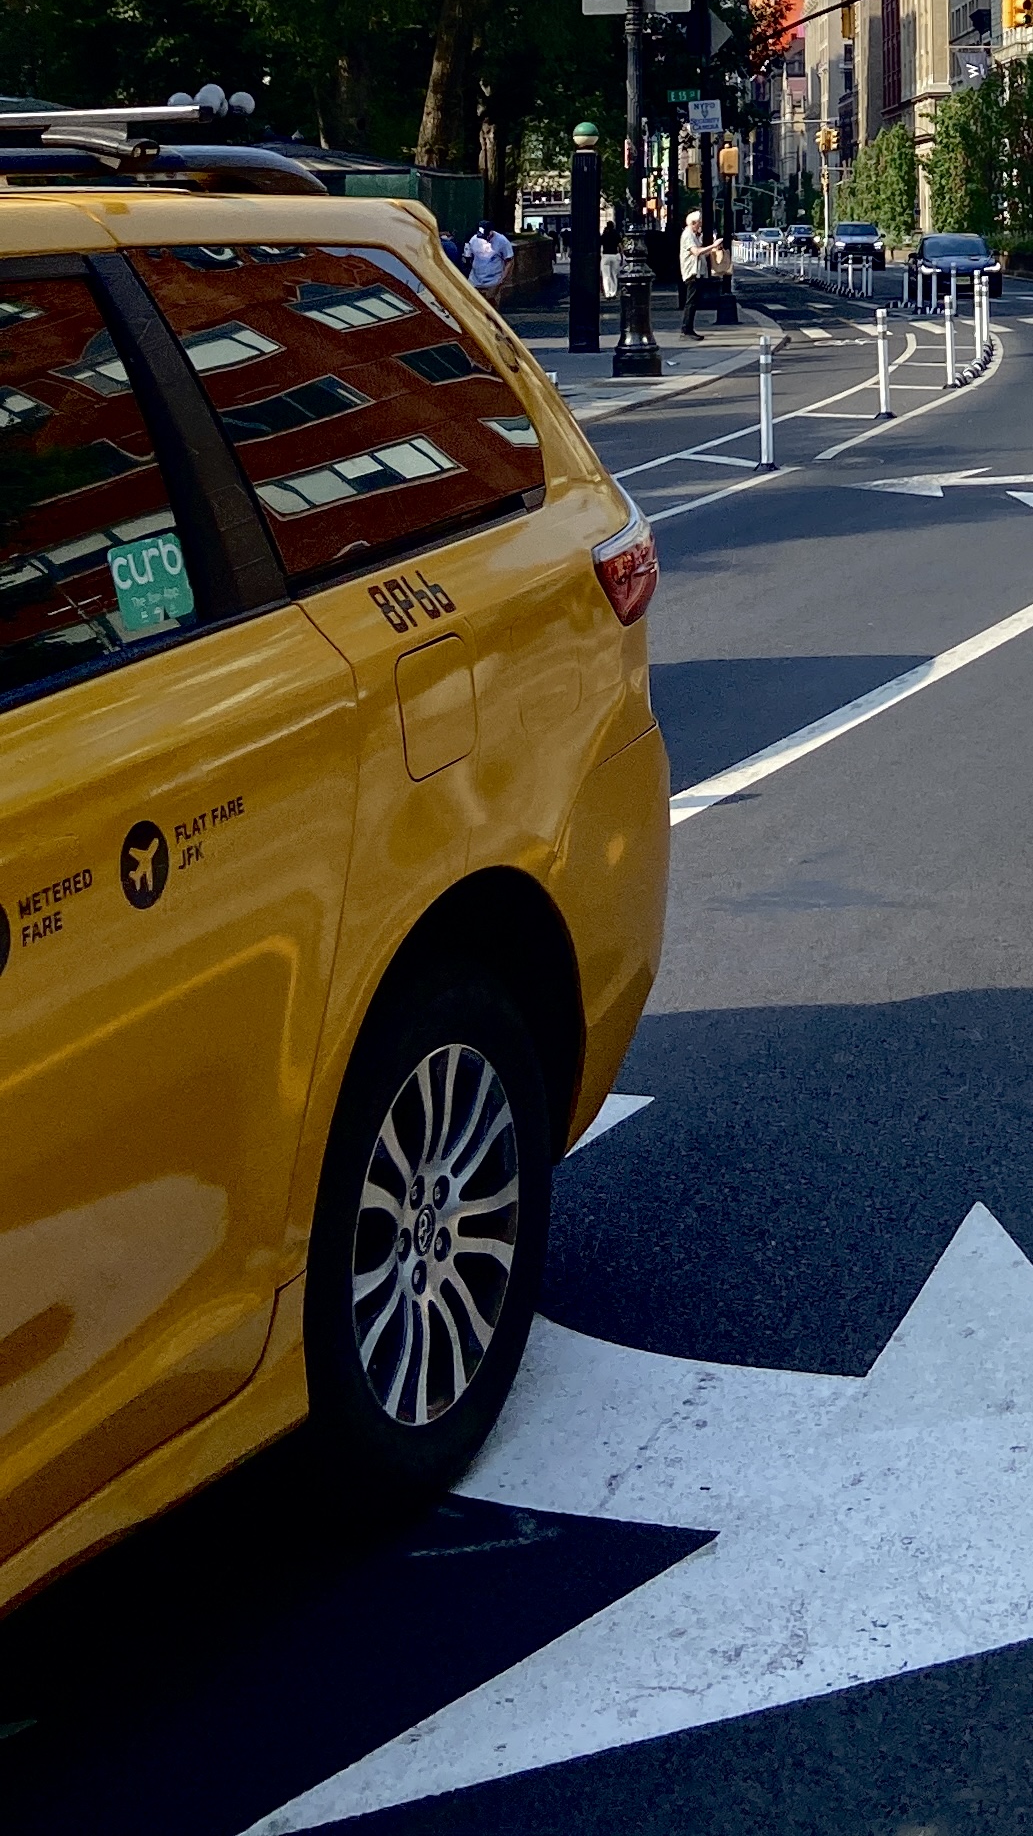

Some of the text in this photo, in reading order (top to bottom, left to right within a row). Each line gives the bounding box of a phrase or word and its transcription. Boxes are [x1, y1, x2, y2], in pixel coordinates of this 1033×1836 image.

[679, 90, 687, 101] 15
[112, 538, 184, 590] curb
[174, 796, 246, 845] FLAT FARE
[178, 841, 204, 870] JFK
[18, 868, 93, 919] METERED
[21, 911, 63, 947] FARE
